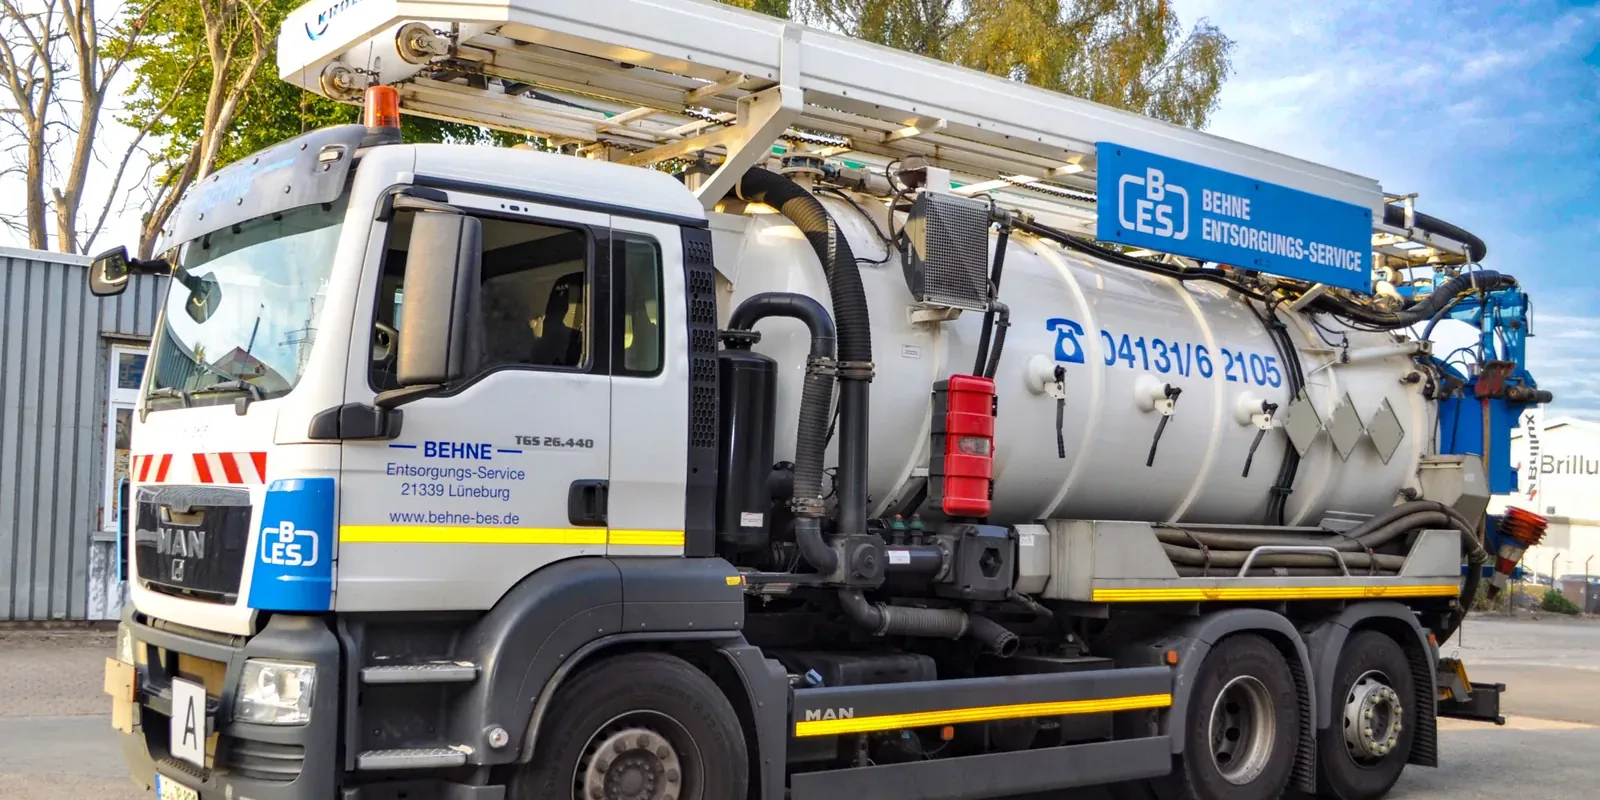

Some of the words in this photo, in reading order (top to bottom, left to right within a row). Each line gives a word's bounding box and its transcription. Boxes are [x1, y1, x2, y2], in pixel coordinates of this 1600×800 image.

[1202, 189, 1251, 221] BEHNE
[1202, 219, 1362, 272] ENTSORGUNGS-SERVICE
[1220, 348, 1282, 388] 2105
[424, 441, 492, 460] BEHNE
[515, 435, 540, 447] TGS
[543, 436, 595, 449] 26.440
[386, 462, 525, 481] Entsorgungs-Service
[1541, 454, 1599, 475] Brillu
[401, 483, 445, 497] 21339
[449, 484, 510, 501] Lüneburg
[389, 511, 520, 526] www.behne-bes.de
[156, 527, 206, 559] MAN
[183, 695, 198, 750] A
[805, 707, 854, 721] MAN
